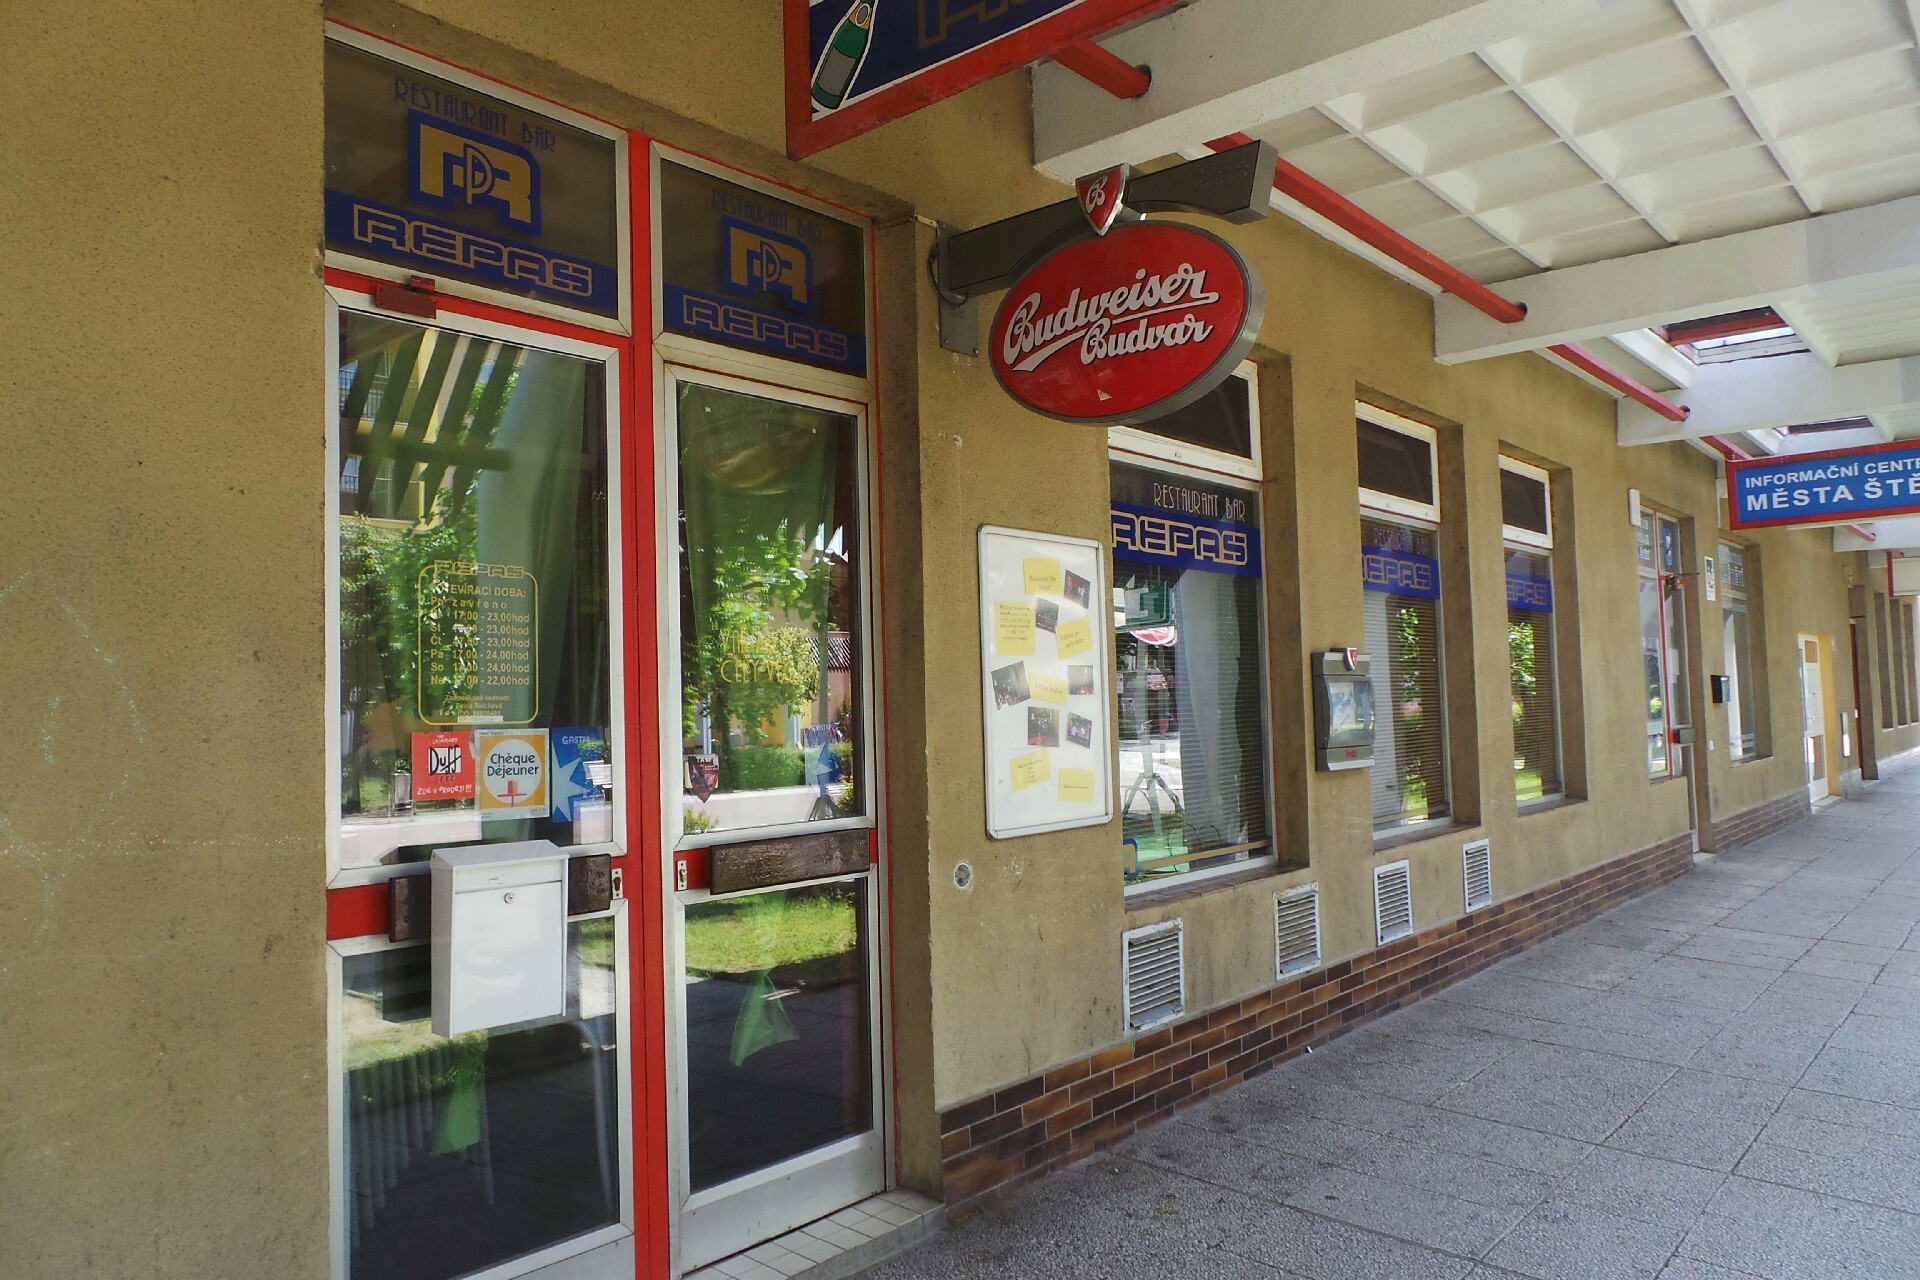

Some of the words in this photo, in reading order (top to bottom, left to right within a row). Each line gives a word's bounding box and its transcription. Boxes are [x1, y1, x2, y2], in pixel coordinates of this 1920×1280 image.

[394, 77, 508, 136] RESTAURANT
[522, 120, 556, 153] BAR
[353, 204, 593, 297] REPAS
[683, 294, 847, 361] REPAS
[1004, 263, 1219, 365] Budweiser
[1081, 313, 1214, 365] Budvar
[1745, 463, 1859, 488] INFORMAČNÍ
[1747, 484, 1854, 511] MĚSTA
[1864, 472, 1920, 499] ŠTĚ
[1153, 483, 1218, 517] RESTAURANT
[1225, 497, 1246, 522] BAR
[1111, 510, 1248, 566] REPAS
[433, 581, 492, 596] EVÍRACÍ
[494, 586, 526, 598] DOBA:
[1361, 553, 1432, 590] EPAS
[487, 650, 529, 660] 24,00hod
[487, 663, 529, 673] 24,00hod
[487, 675, 529, 685] 22,00hod
[487, 764, 540, 779] Déjeuner
[490, 752, 536, 766] Chèque
